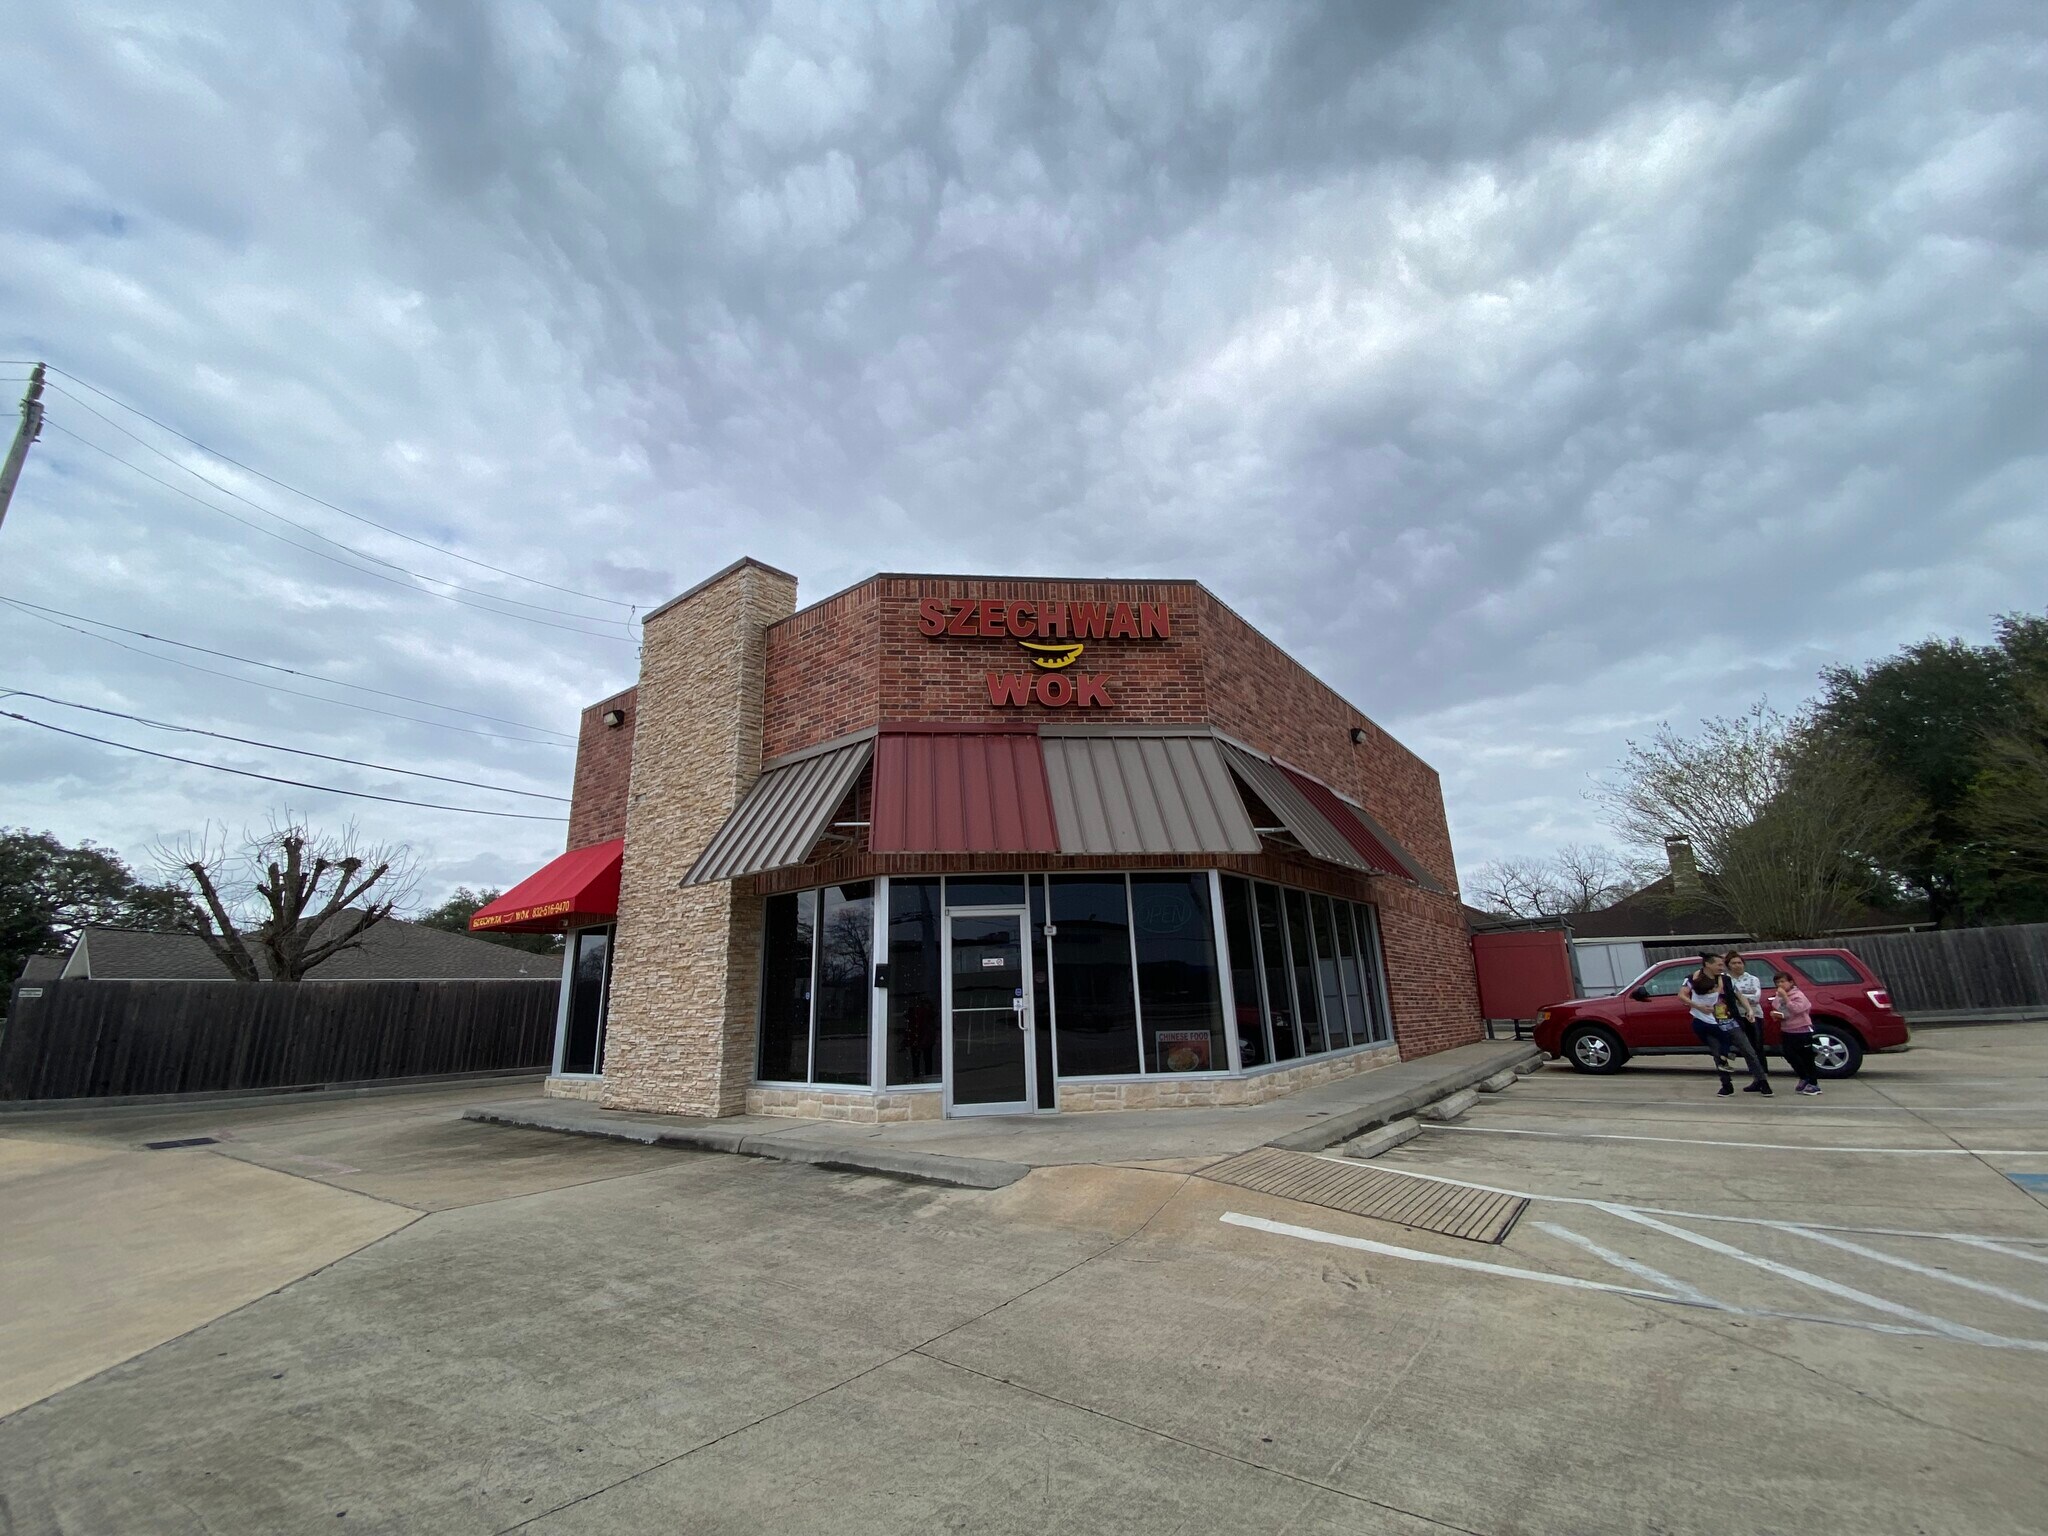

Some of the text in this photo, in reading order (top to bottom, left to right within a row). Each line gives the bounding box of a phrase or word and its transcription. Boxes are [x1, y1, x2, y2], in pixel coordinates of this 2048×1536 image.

[917, 599, 1171, 638] SZECHWAN
[986, 672, 1114, 706] WOK
[1137, 904, 1185, 924] OPEN
[1158, 1031, 1209, 1041] CHINESE FOOD
